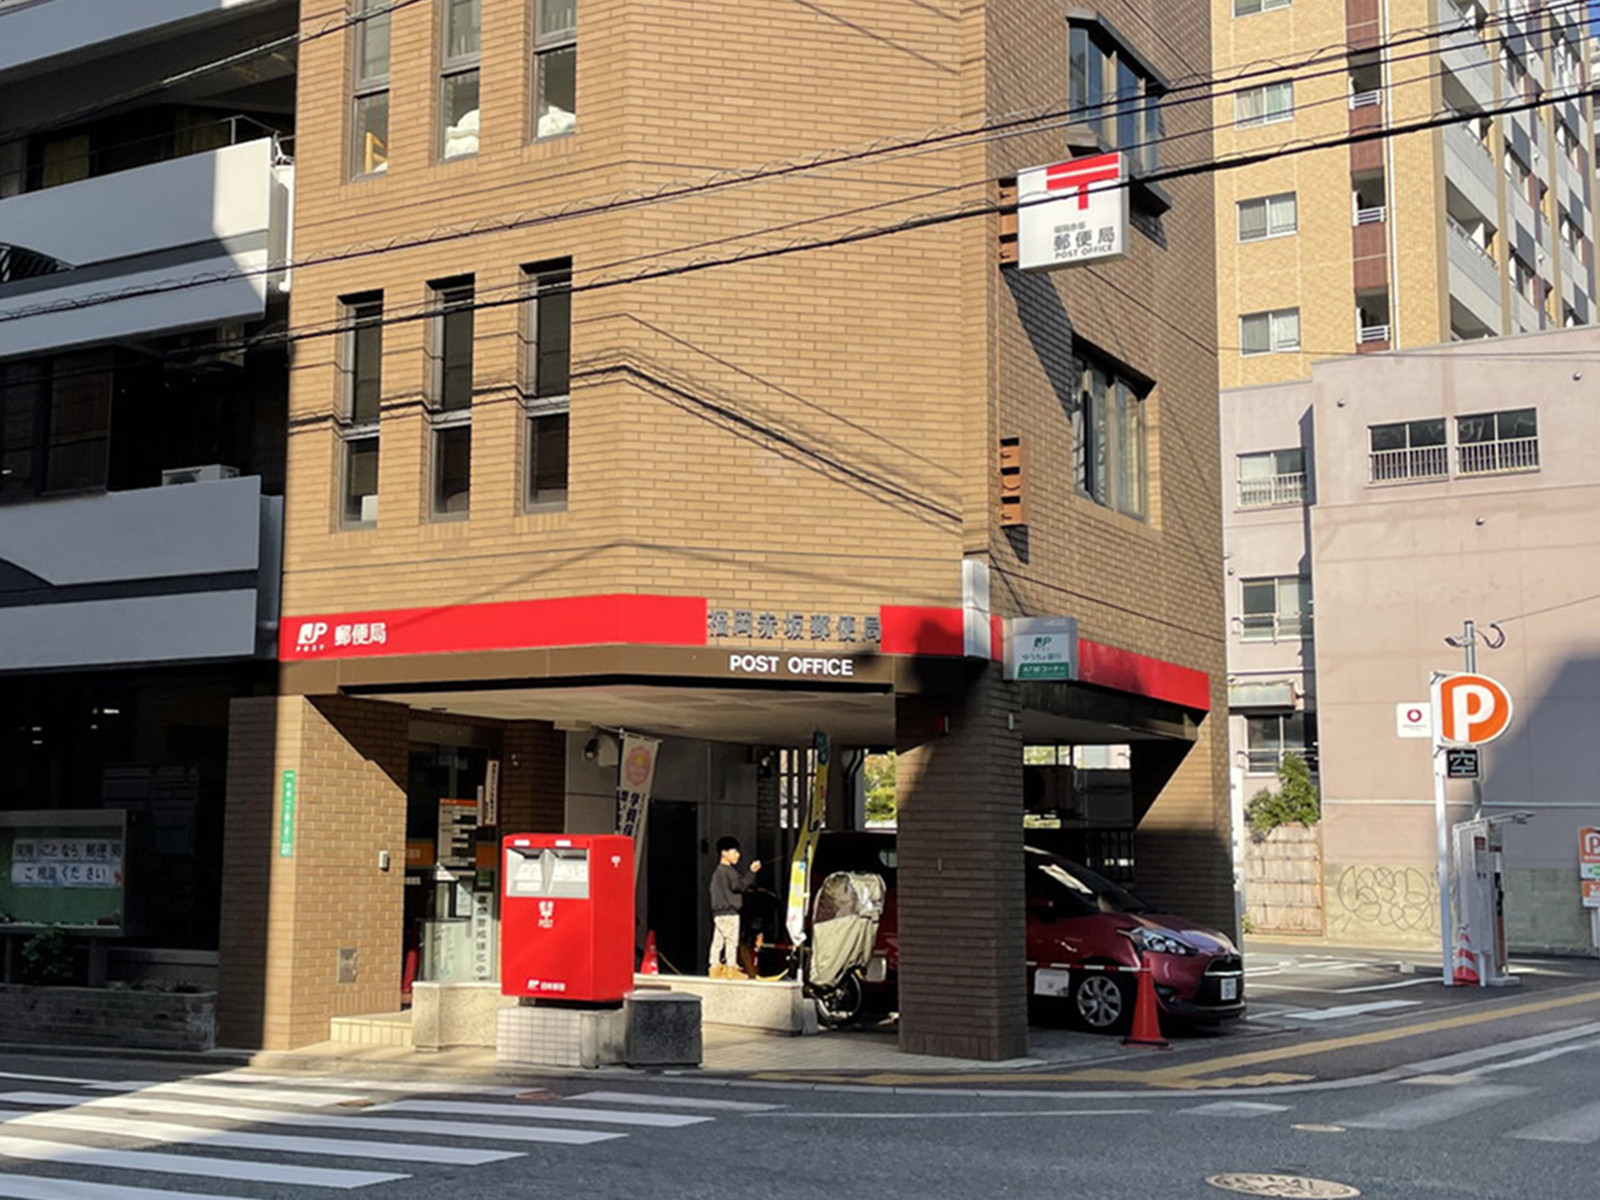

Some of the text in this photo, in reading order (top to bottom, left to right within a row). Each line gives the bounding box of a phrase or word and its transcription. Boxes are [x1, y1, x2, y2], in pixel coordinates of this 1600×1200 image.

[1054, 226, 1115, 251] 郵便局
[1055, 243, 1112, 259] POST OFFICE
[334, 622, 387, 646] 郵便局
[707, 610, 882, 643] 福岡赤坂郵便局
[729, 654, 854, 677] POST OFFICE
[1453, 684, 1496, 743] P
[1450, 751, 1476, 776] 空
